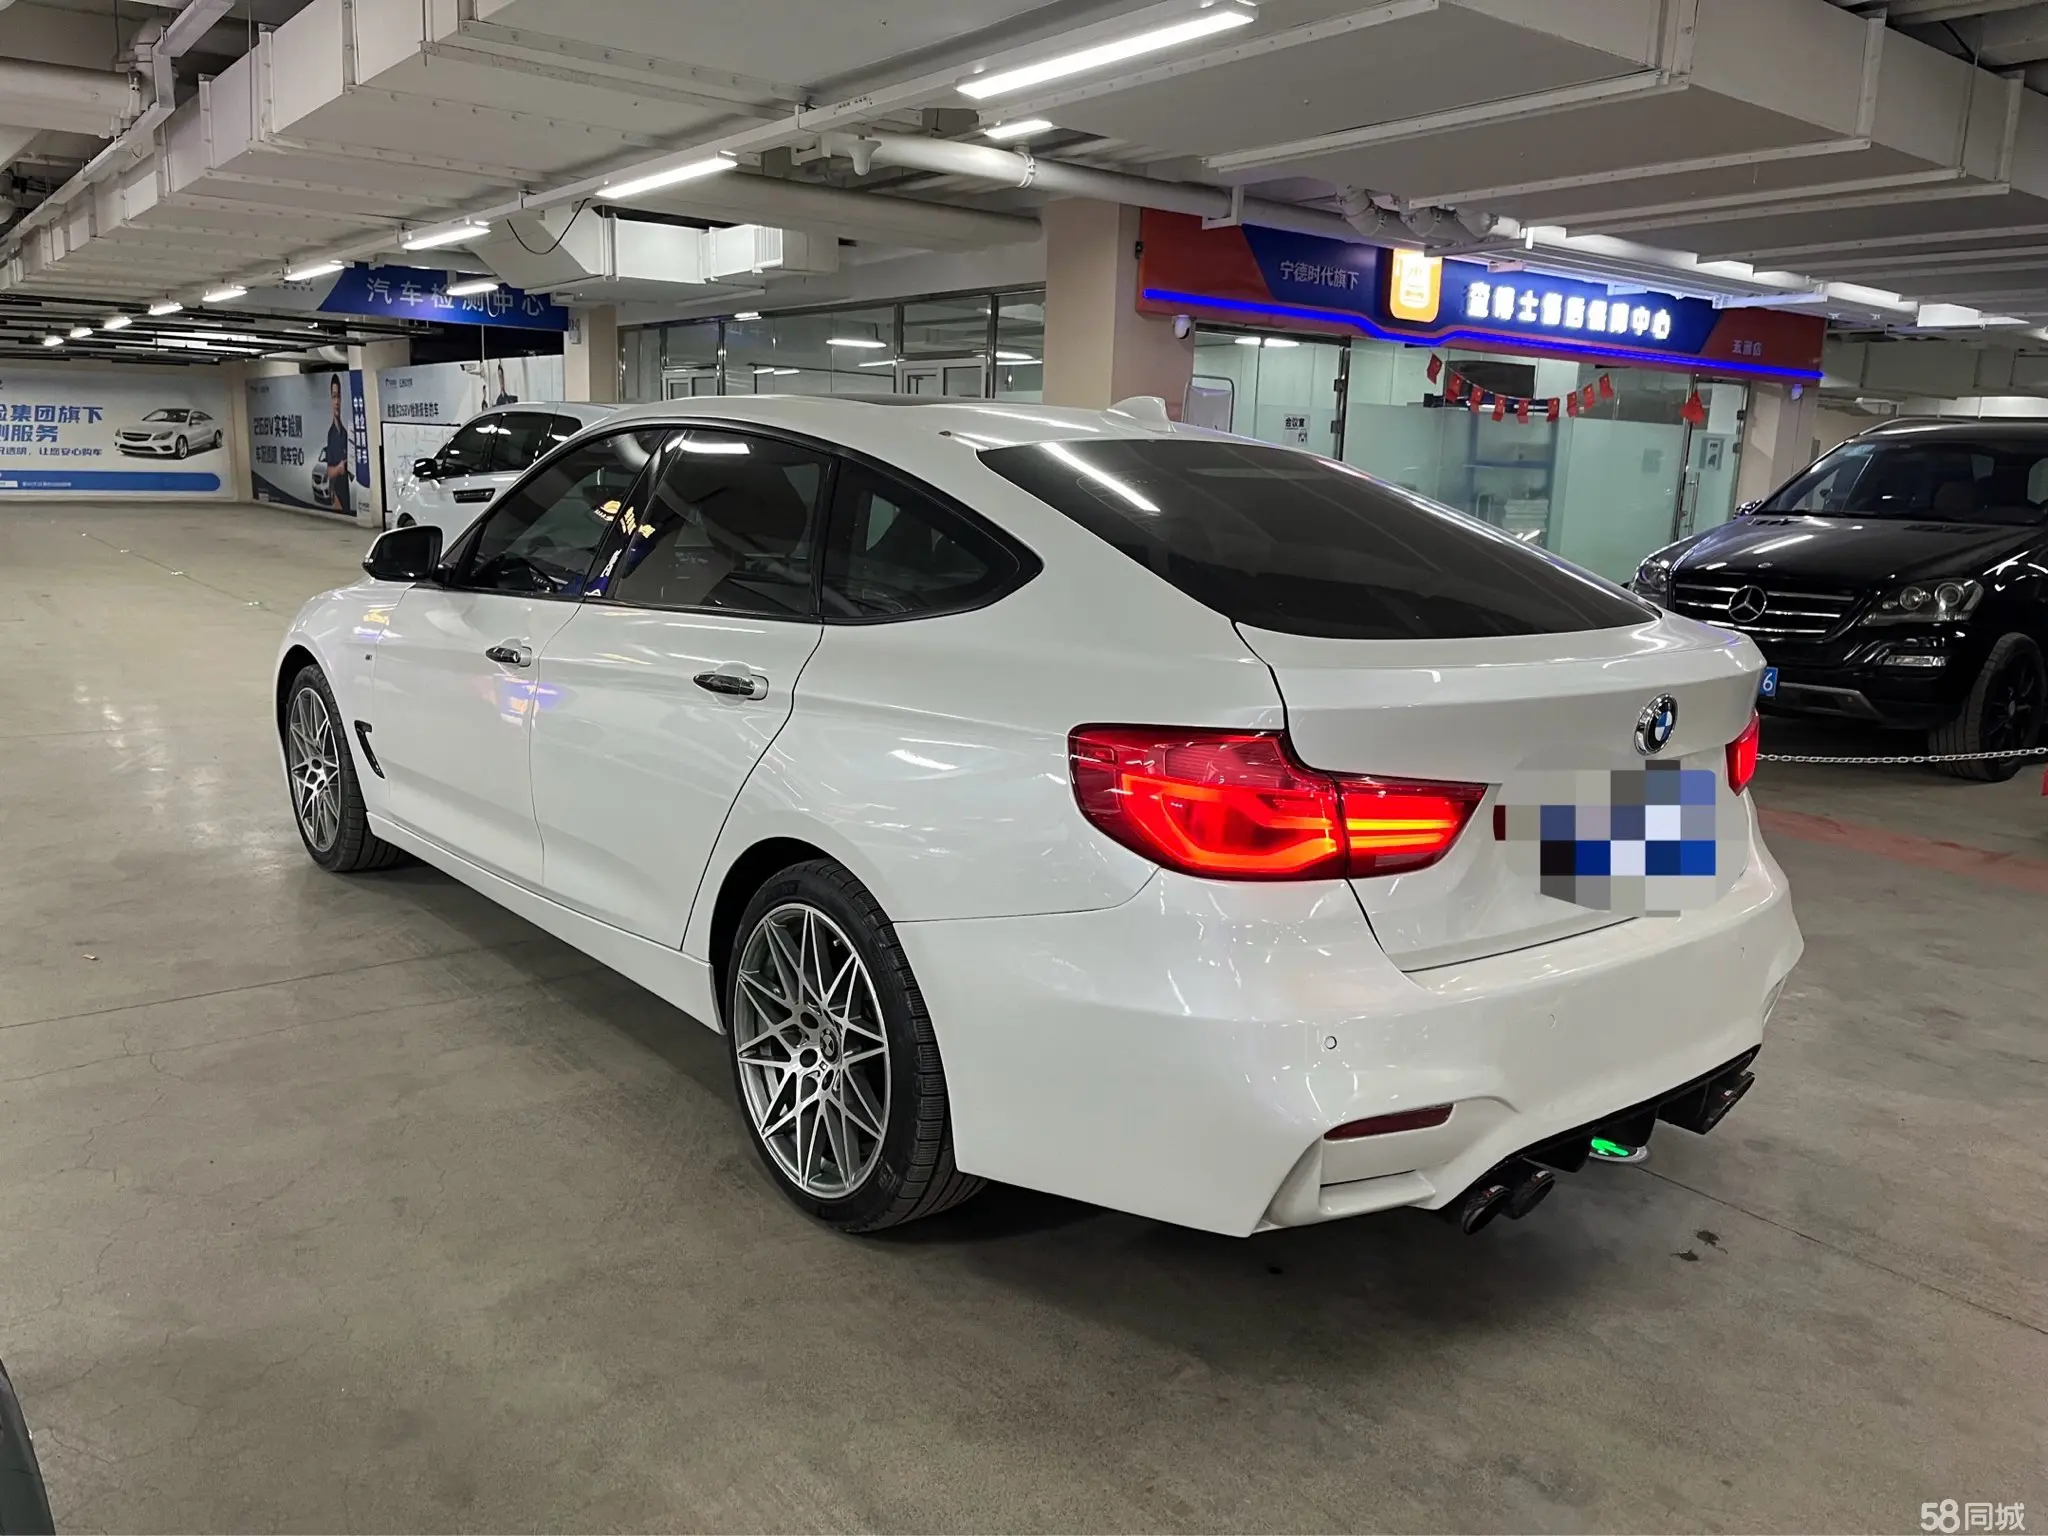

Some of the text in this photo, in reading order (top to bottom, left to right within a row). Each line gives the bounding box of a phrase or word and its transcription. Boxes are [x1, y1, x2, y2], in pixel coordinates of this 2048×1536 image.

[1280, 260, 1360, 290] 宁德时代旗下
[366, 277, 545, 316] 汽车检测中心
